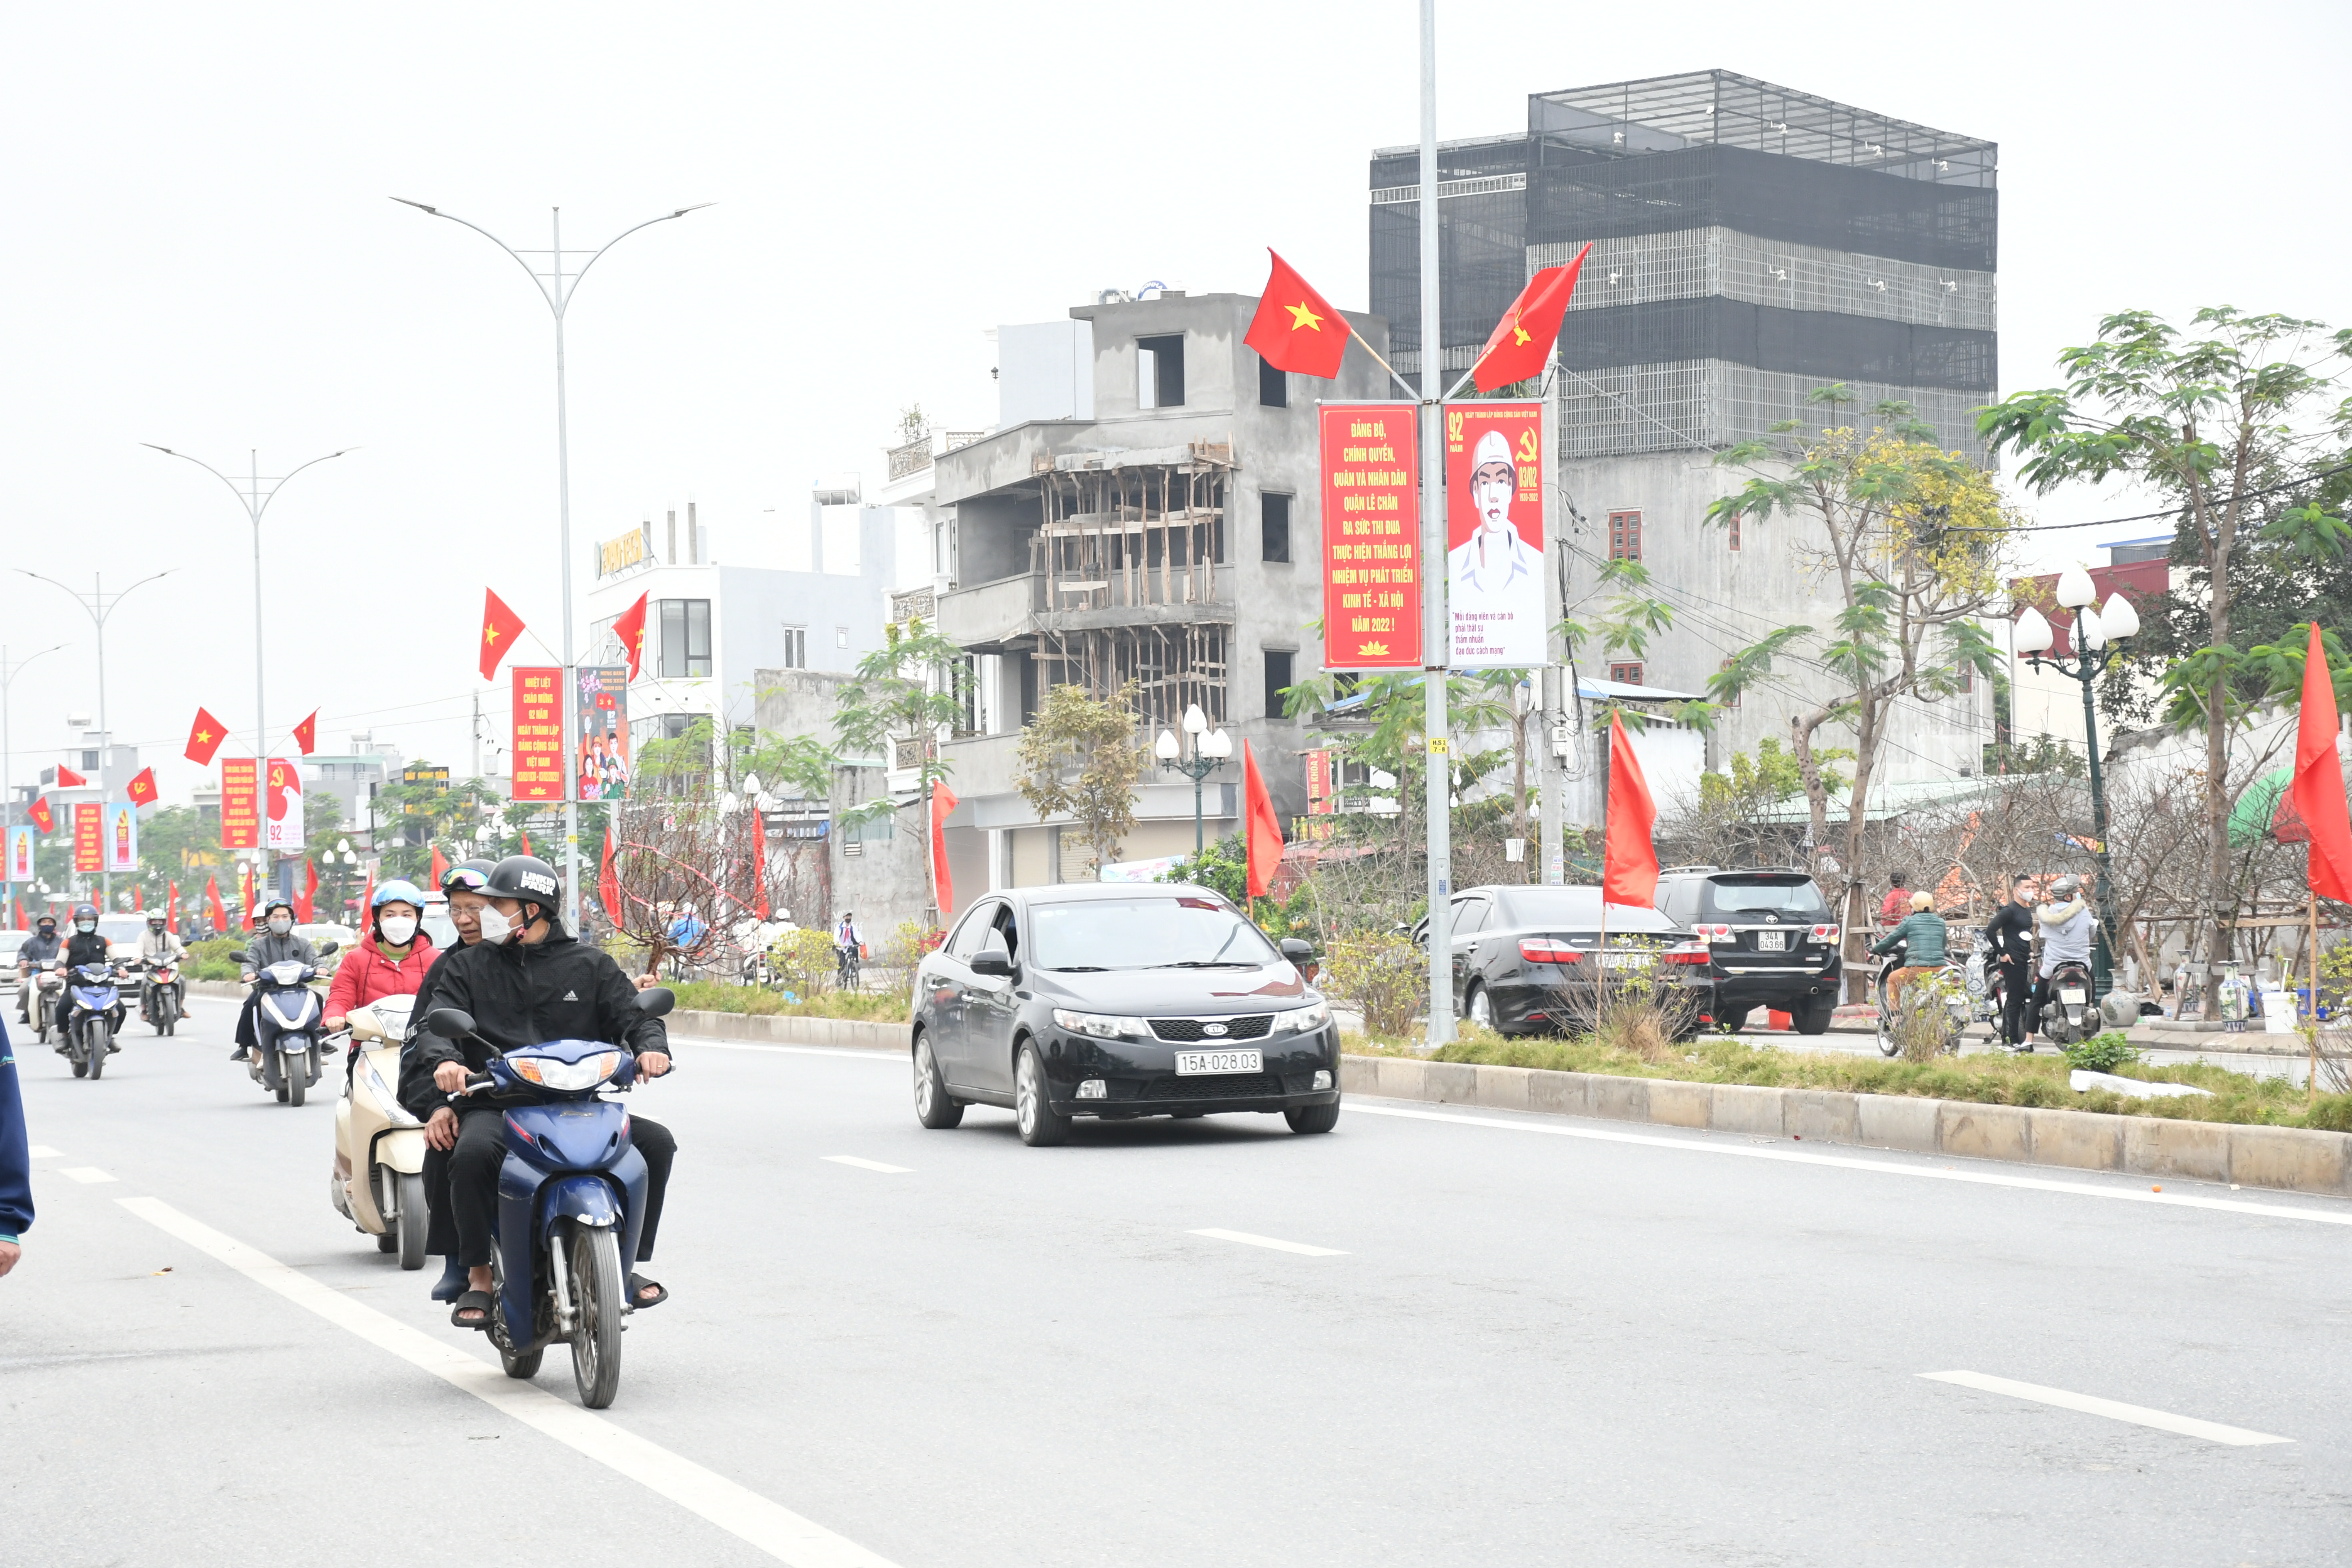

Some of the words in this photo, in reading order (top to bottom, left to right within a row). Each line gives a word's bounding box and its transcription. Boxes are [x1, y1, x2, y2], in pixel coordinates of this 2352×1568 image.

[1351, 418, 1372, 438] ĐẢNG
[1374, 420, 1387, 440] BỘ,
[1448, 412, 1463, 442] 92
[1344, 445, 1367, 462] CHÍNH
[1369, 443, 1396, 463] QUYỀN,
[1450, 443, 1463, 453] NĂM
[1334, 469, 1355, 488] QUÂN
[1356, 469, 1366, 486] VÀ
[1368, 469, 1389, 486] NHÂN
[1391, 469, 1407, 485] DÂN
[1519, 466, 1537, 488] 03/02
[1344, 493, 1365, 514] QUẬN
[1366, 493, 1375, 510] LÊ
[1377, 493, 1398, 510] CHÂN
[1520, 493, 1538, 501] 1930-2022
[1343, 521, 1353, 535] RA
[1355, 518, 1370, 535] SỨC
[1372, 520, 1383, 534] THI
[1386, 520, 1401, 534] ĐUA
[1333, 544, 1352, 563] THỰC
[1354, 542, 1371, 562] HIỆN
[1373, 540, 1398, 559] THẮNG
[1400, 543, 1411, 562] LỢI
[1332, 567, 1357, 587] NHIỆM
[1359, 569, 1369, 586] VỤ
[1370, 566, 1389, 583] PHÁT
[1391, 563, 1413, 583] TRIỂN
[1343, 594, 1361, 608] KINH
[1363, 589, 1371, 608] TẾ
[1379, 591, 1389, 607] XÃ
[1391, 590, 1404, 611] HỘI
[1352, 615, 1370, 632] NĂM
[1372, 618, 1389, 631] 2022
[1392, 617, 1395, 631] !
[270, 825, 282, 840] 92
[520, 879, 554, 896] PARK
[522, 870, 556, 888] LINKIN
[1182, 1054, 1257, 1071] 15A-028.03
